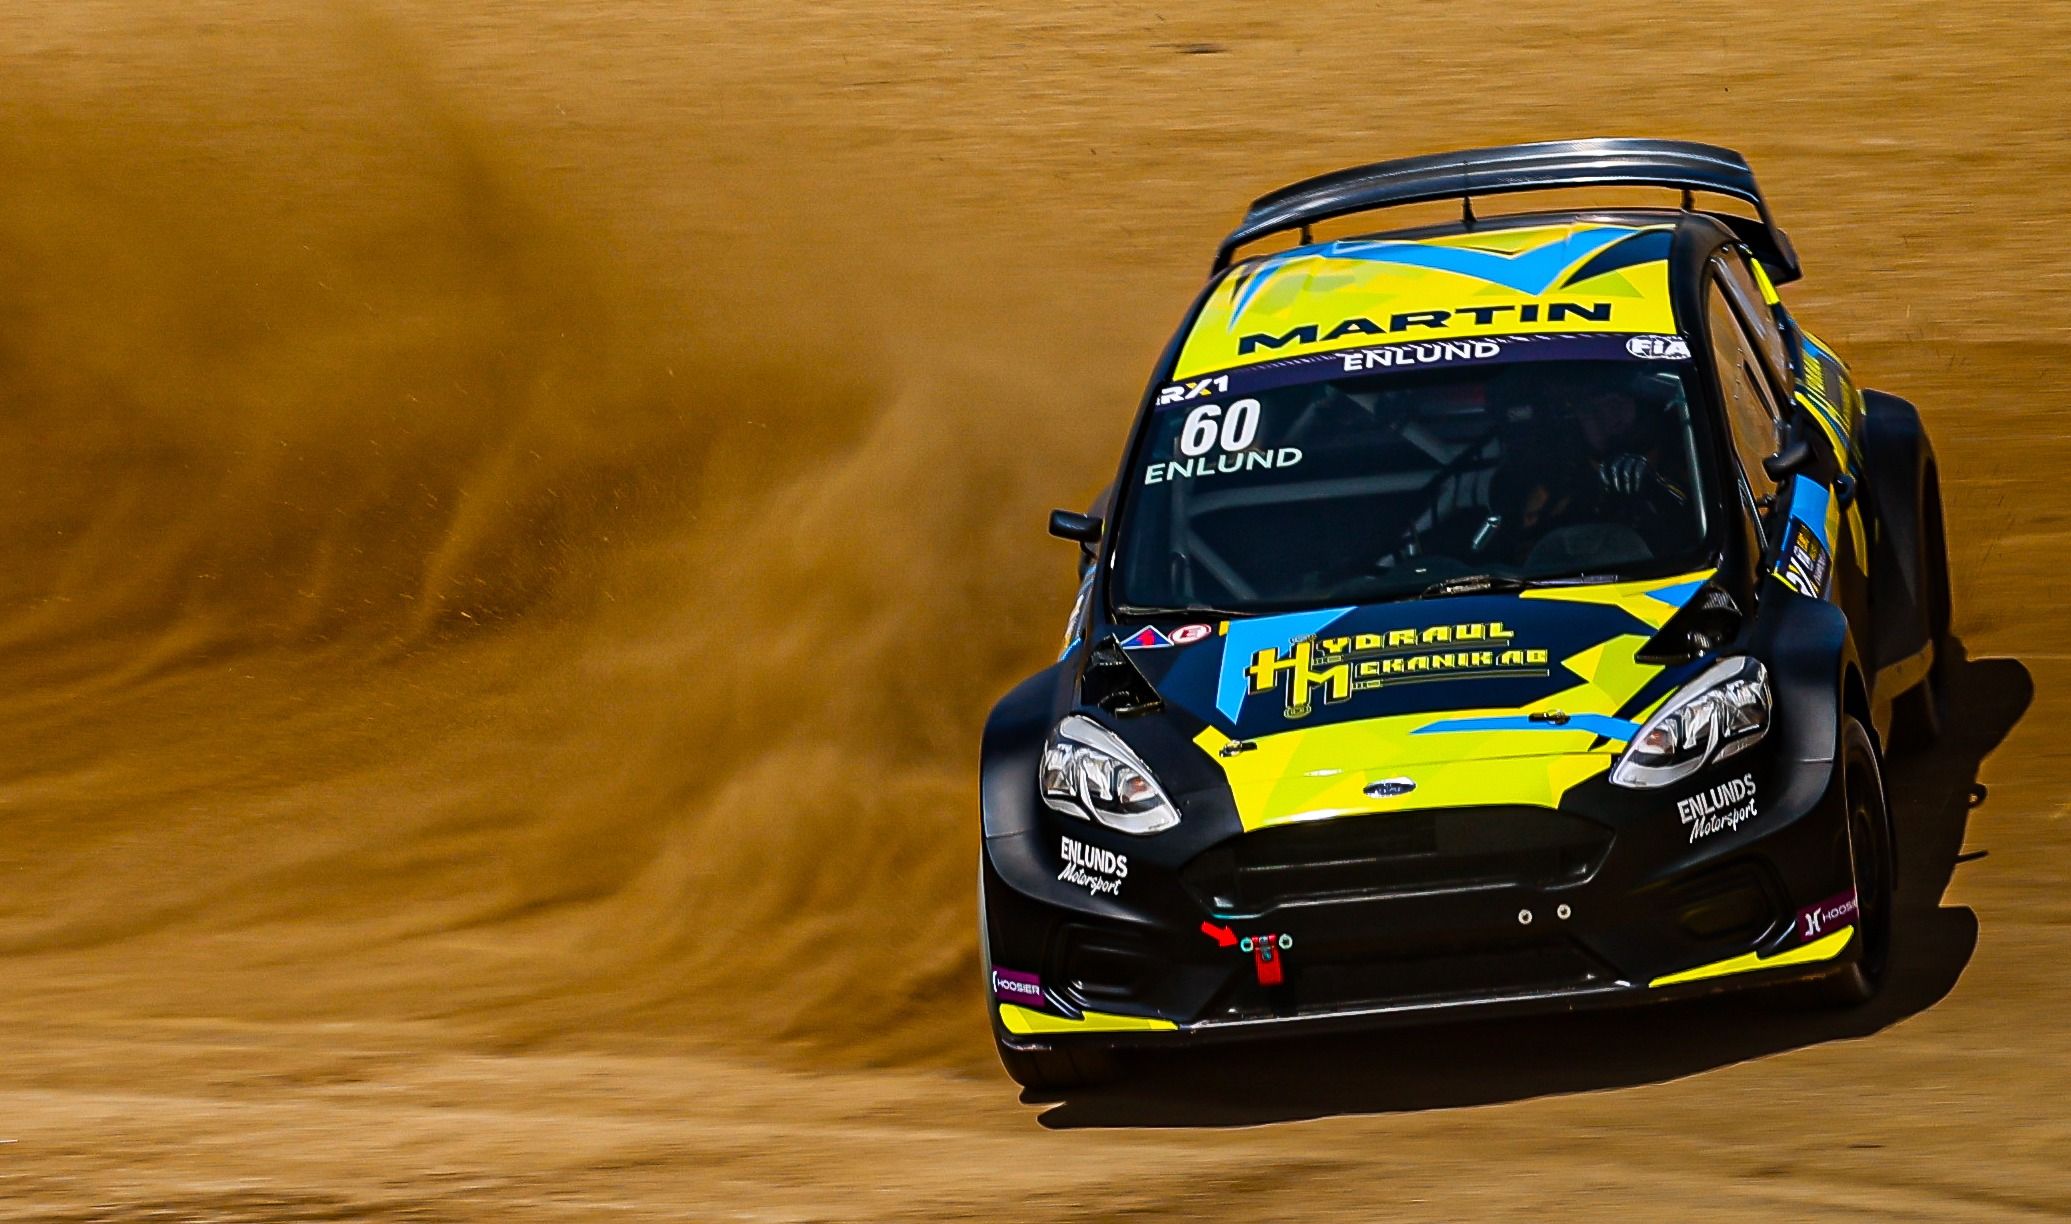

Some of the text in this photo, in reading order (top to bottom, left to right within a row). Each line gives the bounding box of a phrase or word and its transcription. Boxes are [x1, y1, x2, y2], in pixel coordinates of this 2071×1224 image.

[1238, 303, 1612, 356] MARTIN
[1631, 338, 1691, 357] FIA
[1343, 341, 1501, 372] ENLUND
[1180, 398, 1261, 456] 60
[1144, 447, 1303, 485] ENLUND
[1498, 648, 1548, 666] AB
[1677, 772, 1757, 825] ENLUNDS
[1689, 797, 1758, 844] Motorsport
[1061, 835, 1128, 878] ENLUNDS
[1057, 861, 1122, 896] Motorsport
[997, 978, 1040, 995] HOOSIER
